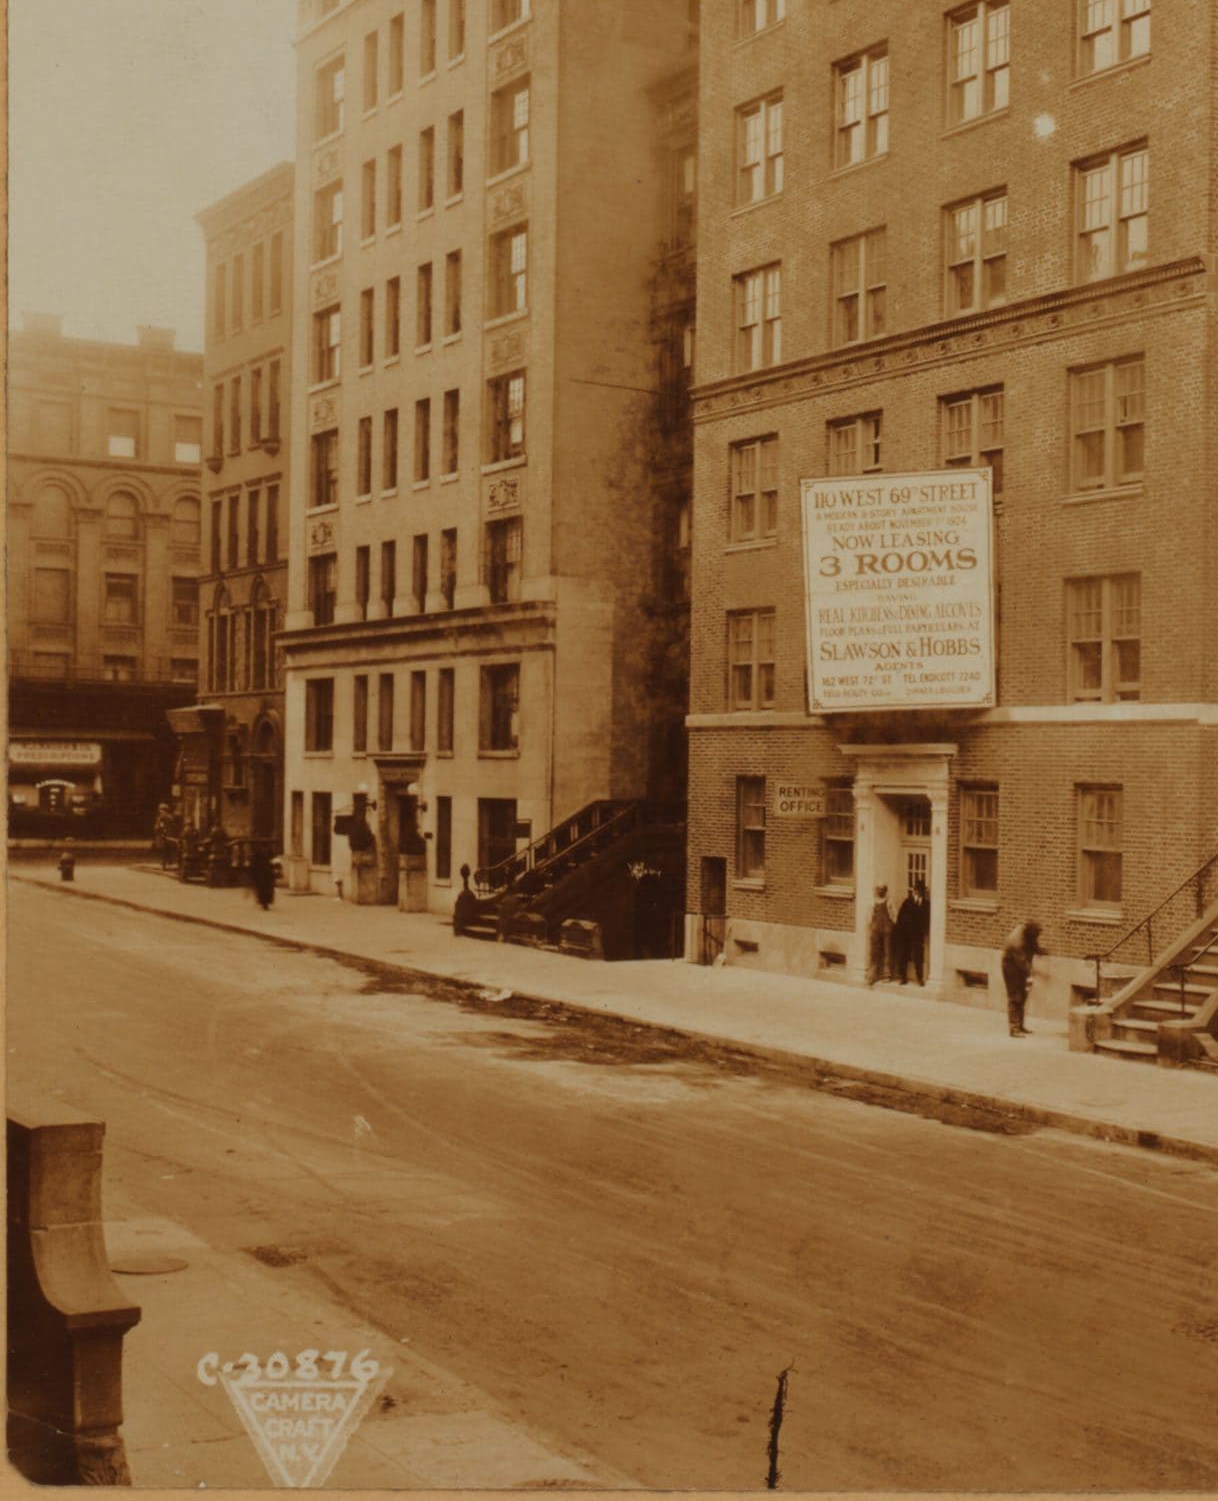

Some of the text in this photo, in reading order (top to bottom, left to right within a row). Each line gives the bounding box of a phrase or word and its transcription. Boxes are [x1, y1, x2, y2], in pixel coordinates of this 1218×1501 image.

[840, 487, 884, 508] WEST
[919, 483, 977, 502] STREET
[858, 519, 885, 532] ABOUT
[833, 531, 960, 551] NOW LEASING
[819, 547, 978, 577] 3 ROOMS
[835, 575, 956, 591] ESPECIALLY DESIRABLE
[819, 607, 844, 625] REAL
[850, 605, 894, 622] KITCHENS
[899, 604, 931, 621] DINING
[935, 601, 983, 619] ALCOVES
[820, 637, 981, 661] SLAWSON & HOBBS
[875, 662, 923, 671] AGENTS
[838, 675, 860, 686] WEST
[779, 787, 825, 798] RENTING
[780, 801, 823, 812] OFFICE
